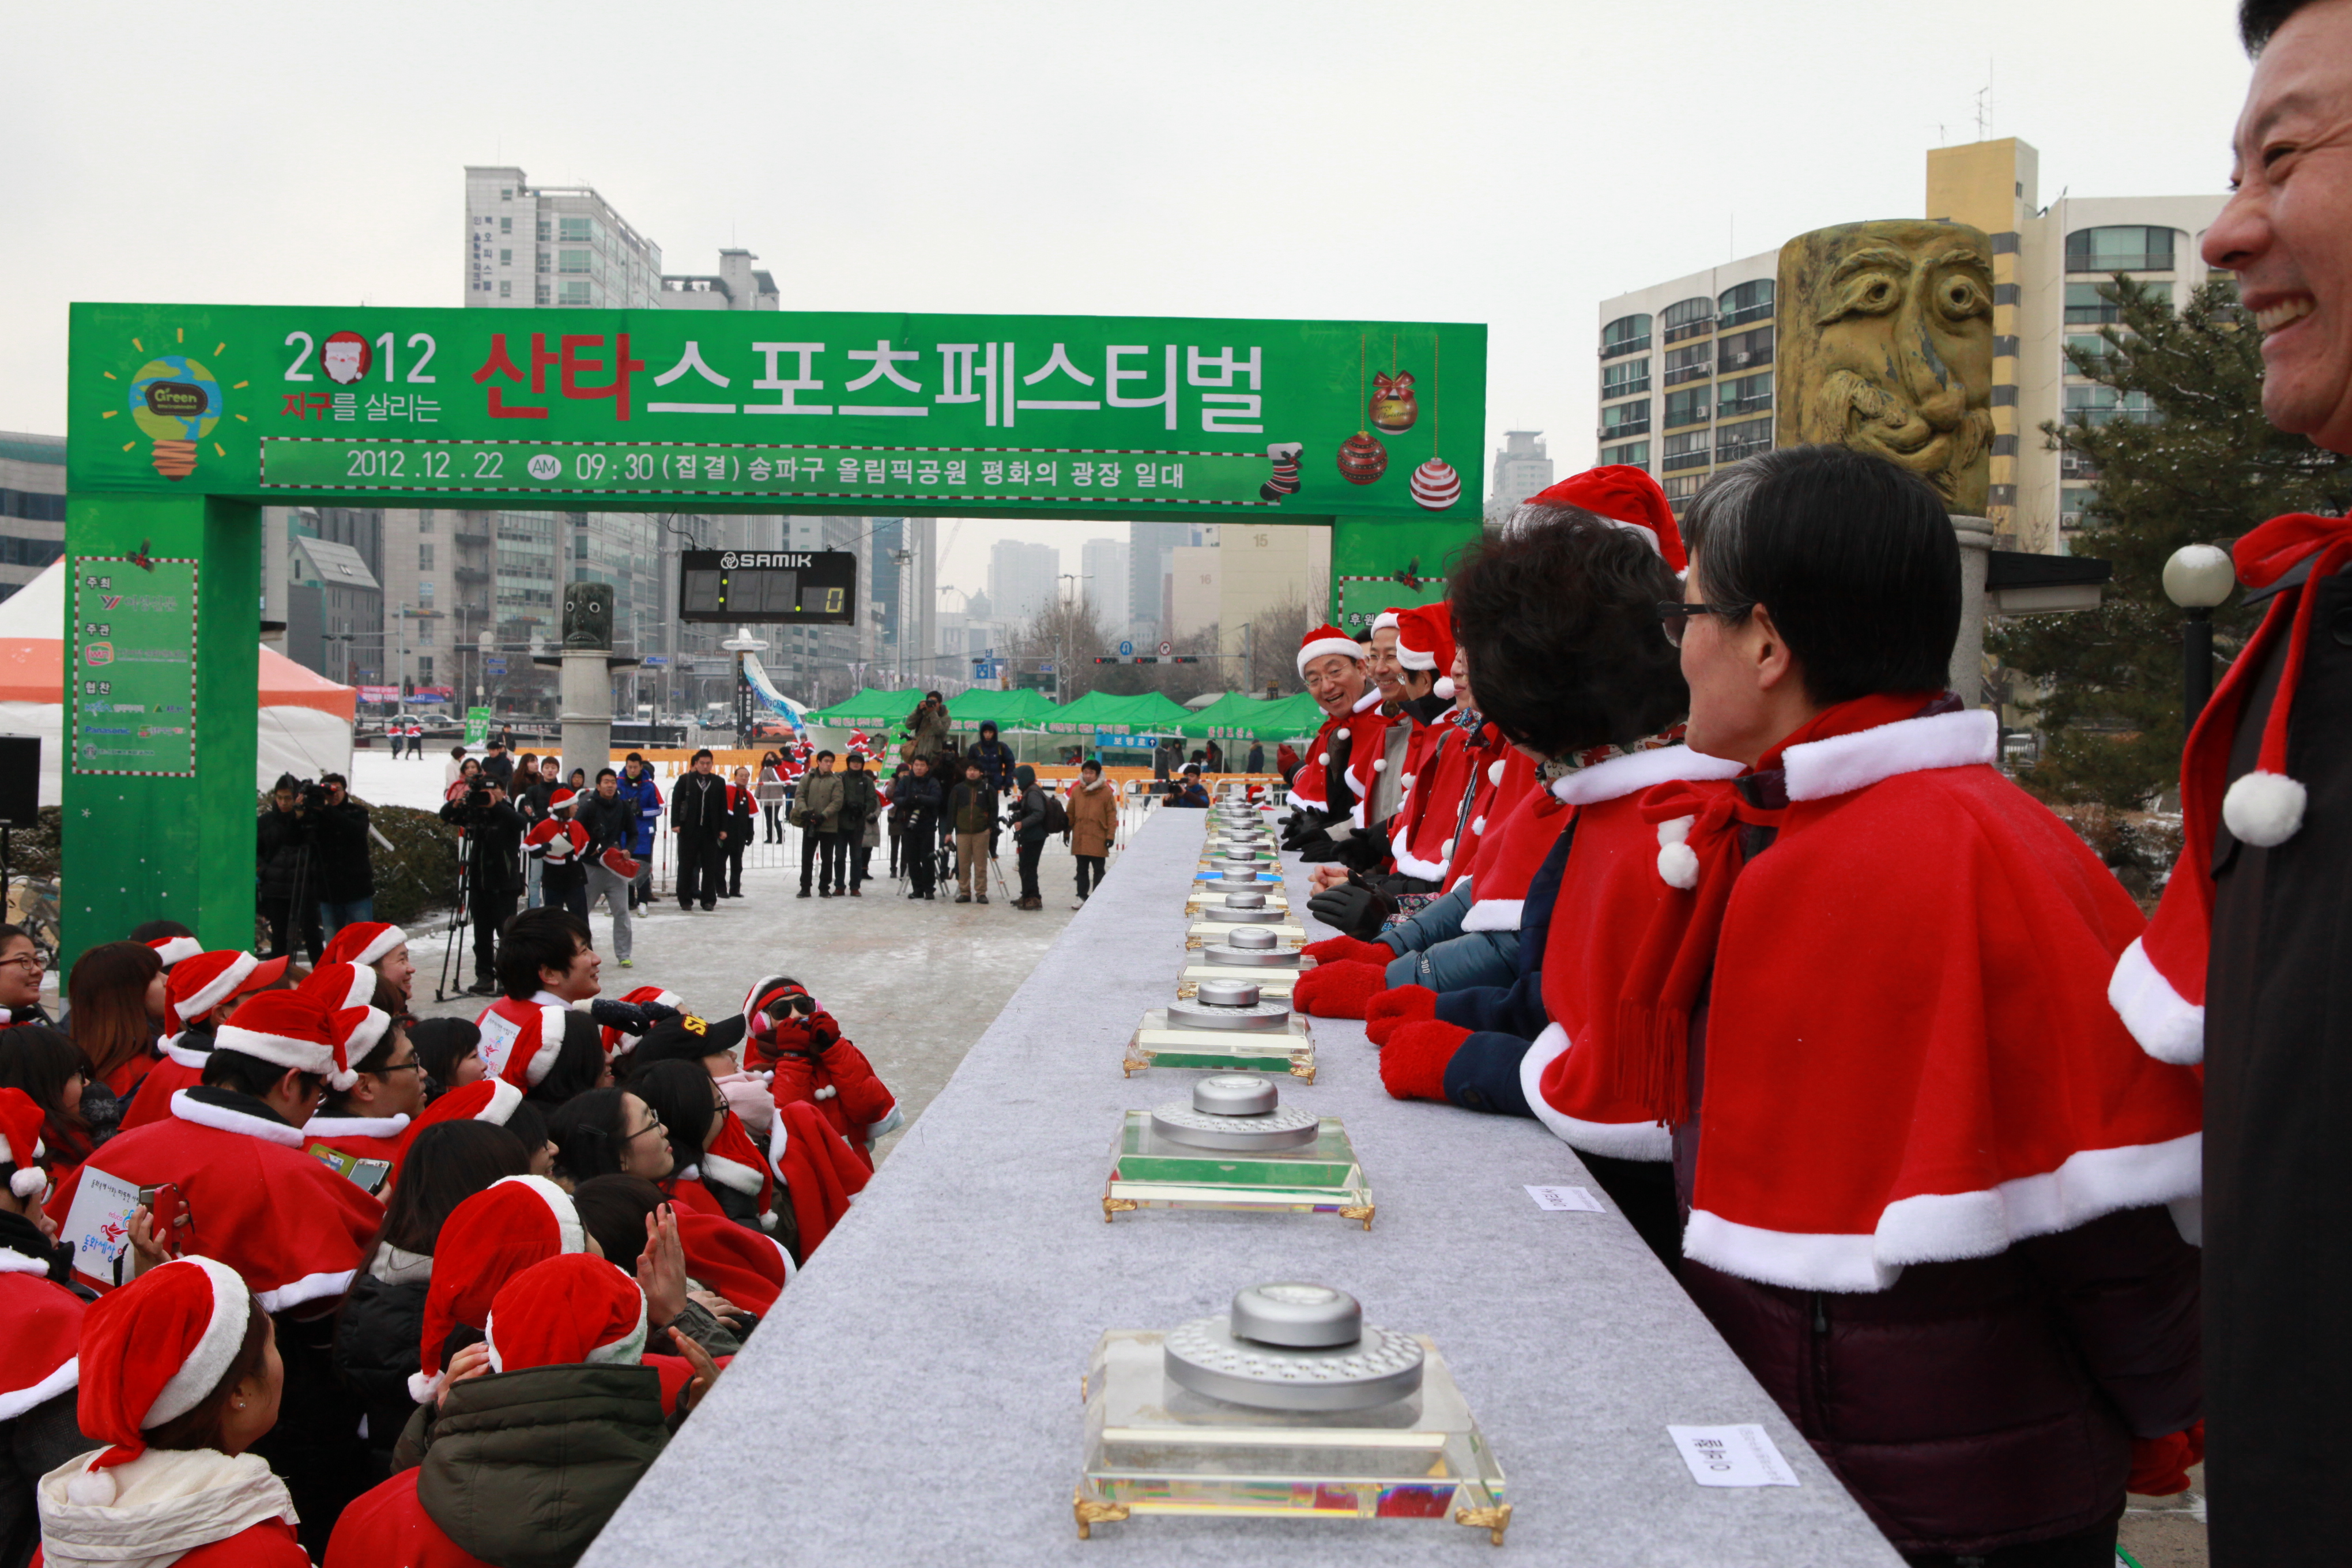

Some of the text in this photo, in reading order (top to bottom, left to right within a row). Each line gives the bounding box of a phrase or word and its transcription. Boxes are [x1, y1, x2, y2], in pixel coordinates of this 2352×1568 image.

[154, 387, 197, 403] Green
[280, 391, 441, 422] 지구를 살리는
[532, 459, 556, 474] AM
[748, 456, 825, 483] 송파구
[836, 457, 967, 485] 올림픽공원
[981, 460, 1057, 486] 평화의
[1071, 461, 1122, 488] 광장
[1135, 462, 1183, 489] 일대
[1253, 533, 1268, 547] 15
[741, 554, 812, 567] SAMIK
[86, 576, 111, 589] 주최
[1200, 574, 1212, 585] 16
[825, 587, 843, 613] 0
[1349, 613, 1375, 627] 후원
[86, 624, 111, 636] 주관
[85, 681, 111, 695] 협찬
[85, 726, 131, 735] Panasonic
[1113, 737, 1146, 746] 보행로
[91, 1179, 107, 1192] 동화속에
[118, 1189, 131, 1203] 따뜻한
[108, 1211, 123, 1222] educo
[82, 1234, 116, 1263] 동화세상
